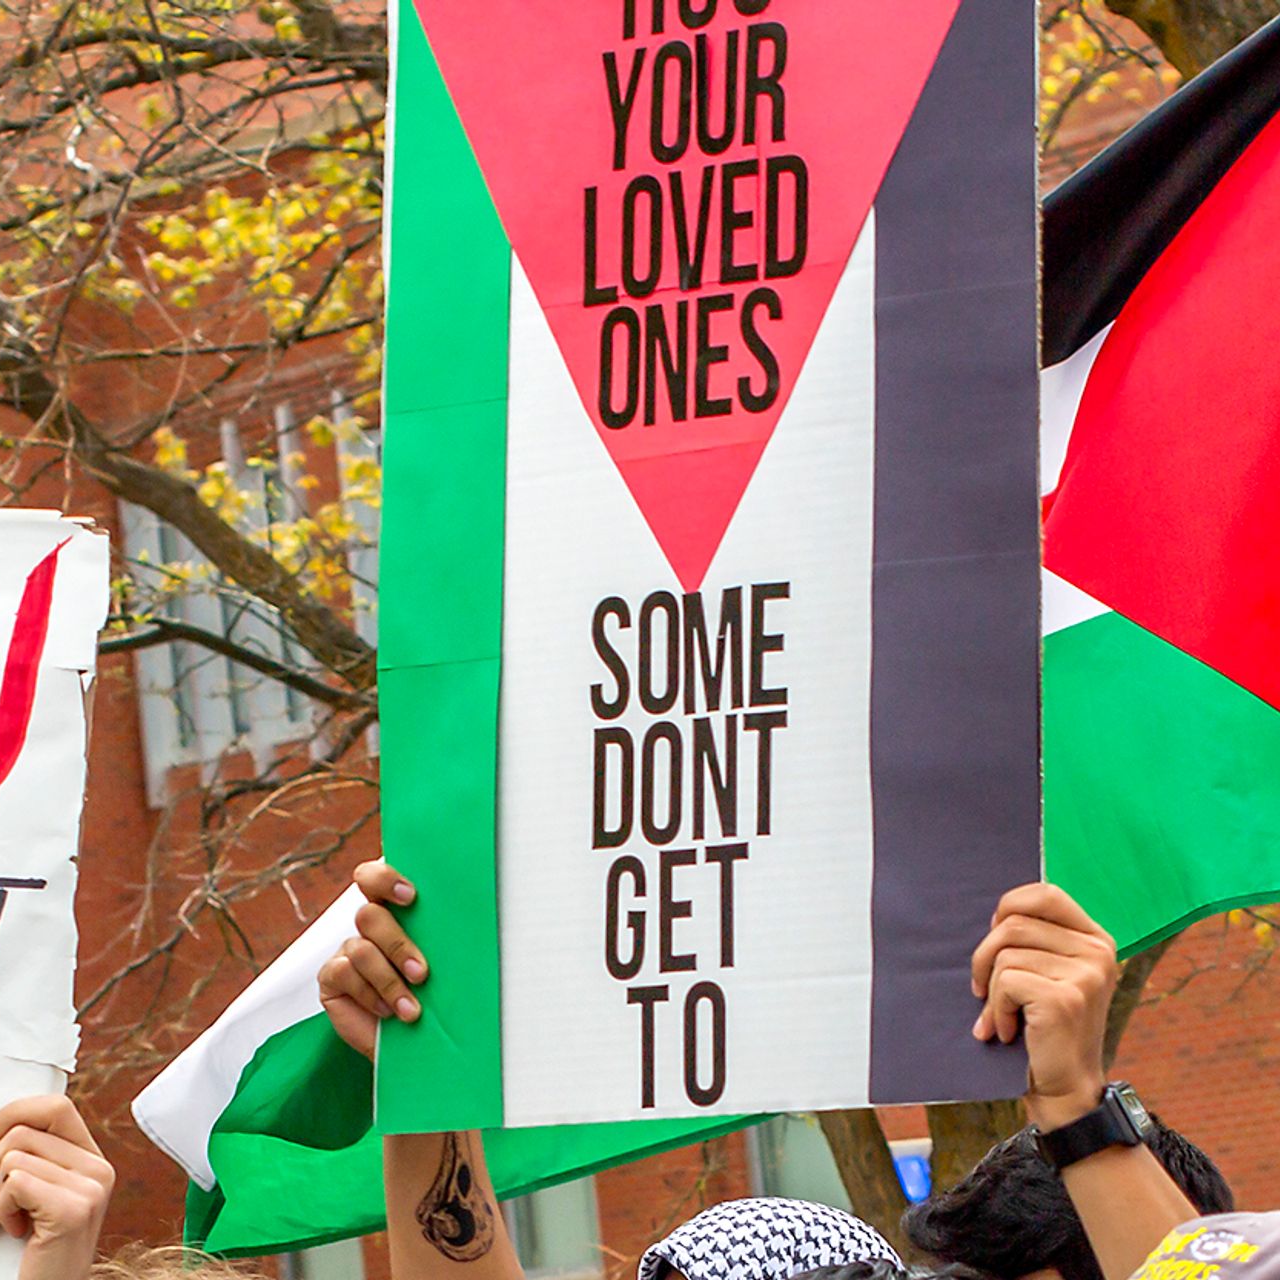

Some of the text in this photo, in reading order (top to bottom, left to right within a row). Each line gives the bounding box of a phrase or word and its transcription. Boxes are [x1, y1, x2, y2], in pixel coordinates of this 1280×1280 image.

[602, 22, 788, 170] YOUR
[583, 155, 809, 307] LOVED
[598, 288, 783, 430] ONES
[590, 581, 791, 720] SOME
[592, 710, 788, 850] DONT
[604, 842, 749, 982] GET
[626, 981, 727, 1109] TO
